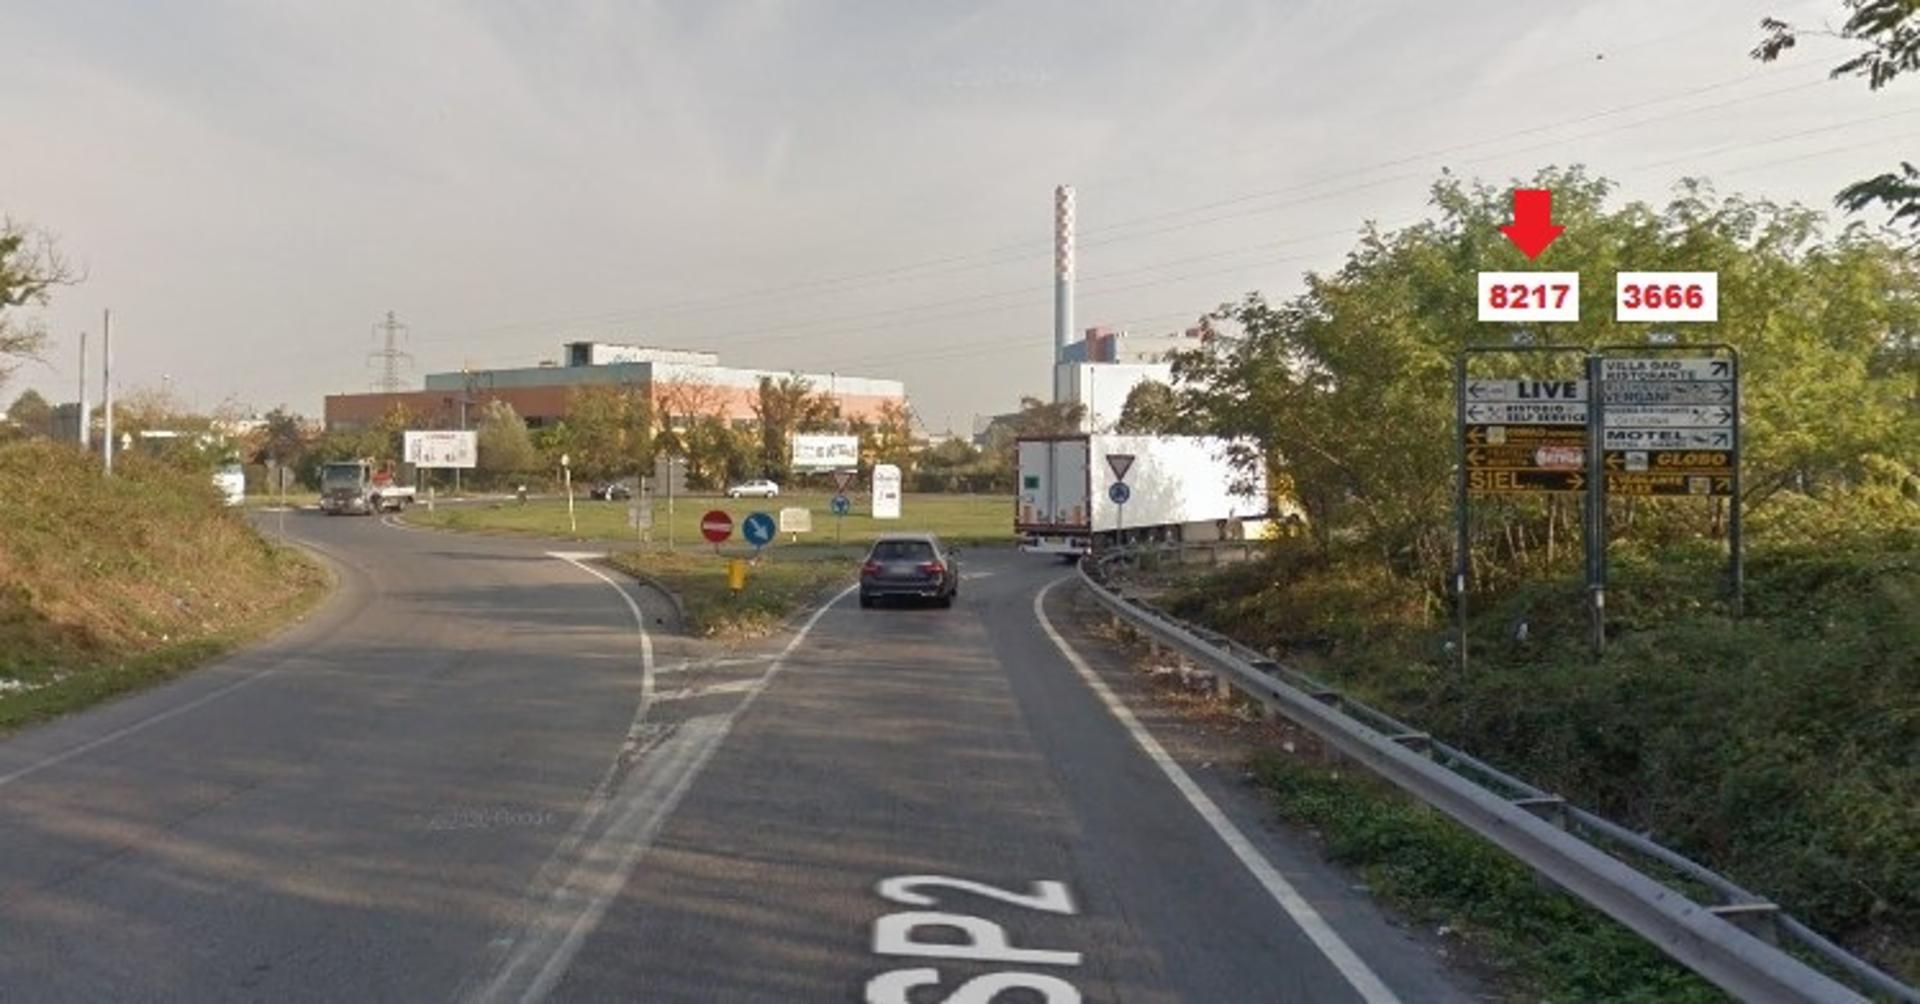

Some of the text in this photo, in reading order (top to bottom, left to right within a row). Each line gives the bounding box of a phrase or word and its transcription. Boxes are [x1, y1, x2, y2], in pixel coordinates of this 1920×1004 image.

[1606, 371, 1696, 380] RISTORANTE
[1518, 382, 1577, 399] LIVE
[1607, 430, 1685, 440] MOTEL
[1657, 453, 1727, 466] GLOBO
[1470, 472, 1524, 489] SIEL
[866, 875, 1082, 1004] SP2
